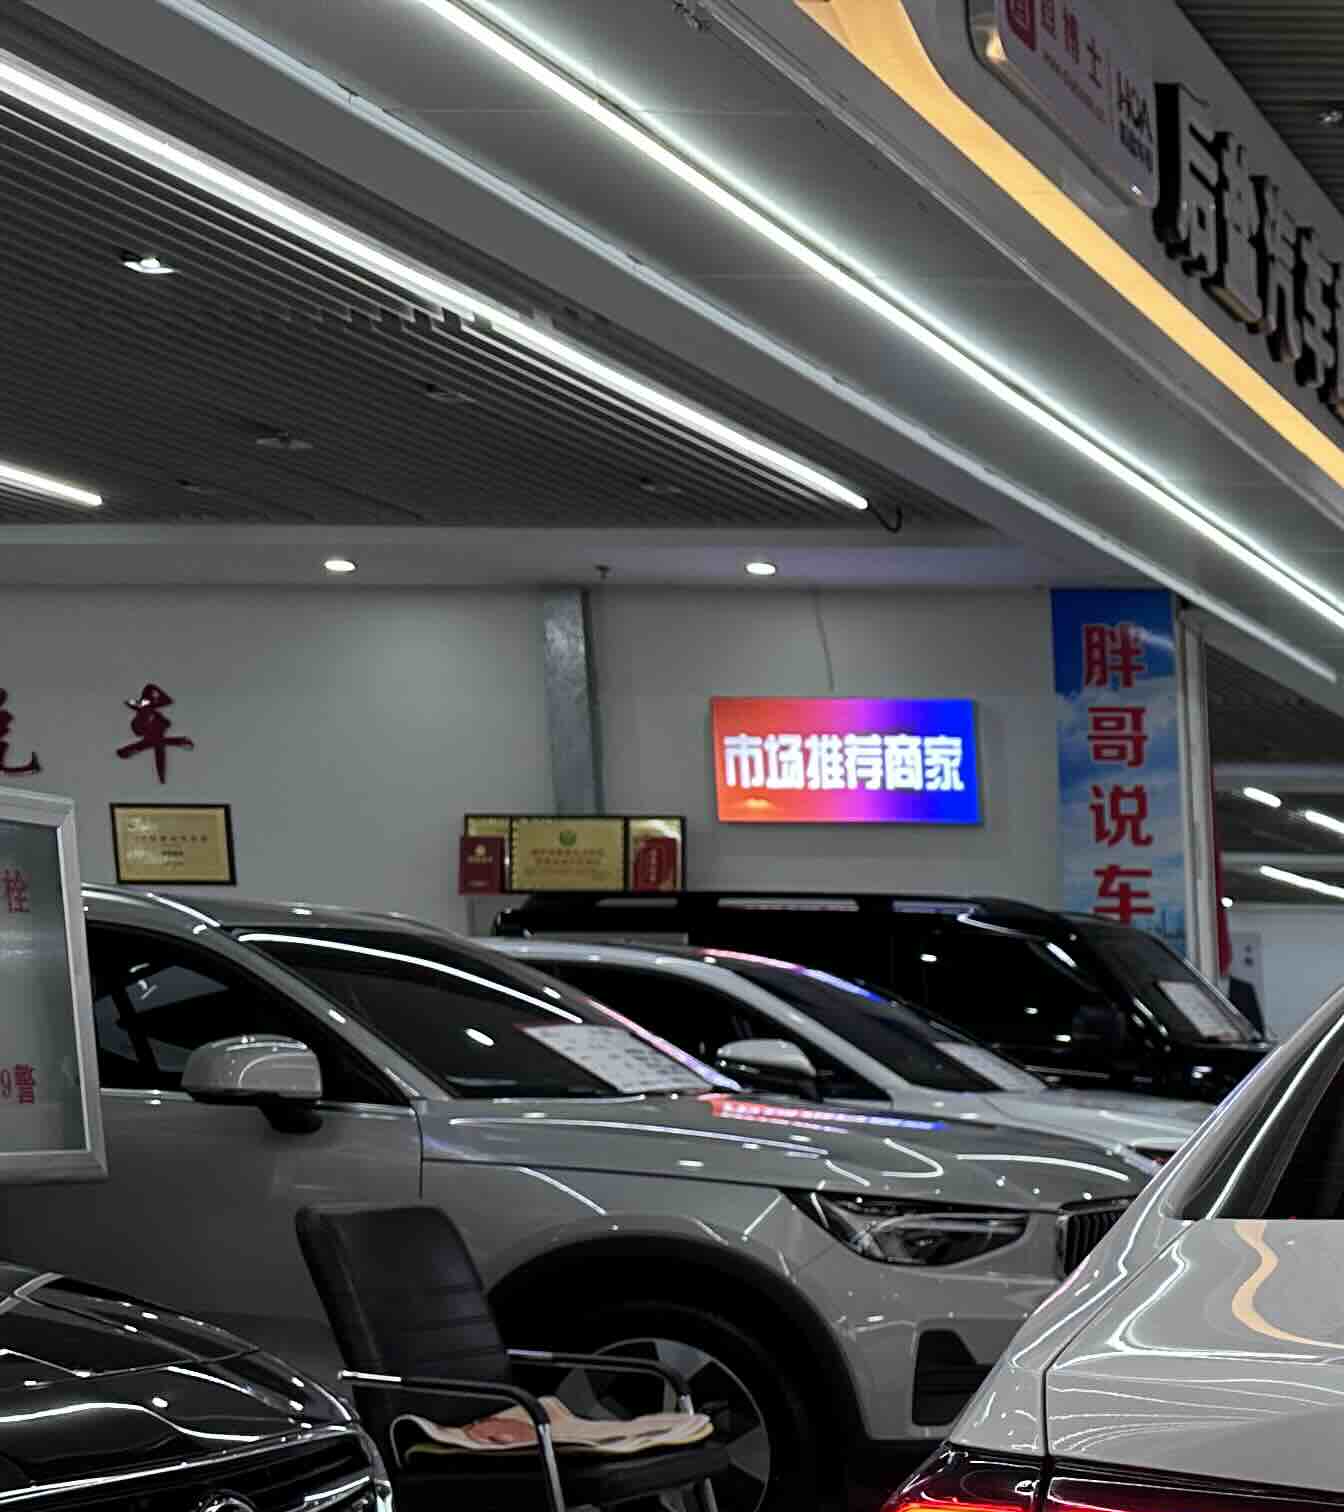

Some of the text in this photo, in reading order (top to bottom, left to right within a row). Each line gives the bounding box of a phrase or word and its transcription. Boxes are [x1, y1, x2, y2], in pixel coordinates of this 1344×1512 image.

[723, 733, 966, 791] 市场推荐商家
[1081, 622, 1156, 926] 胖哥说车
